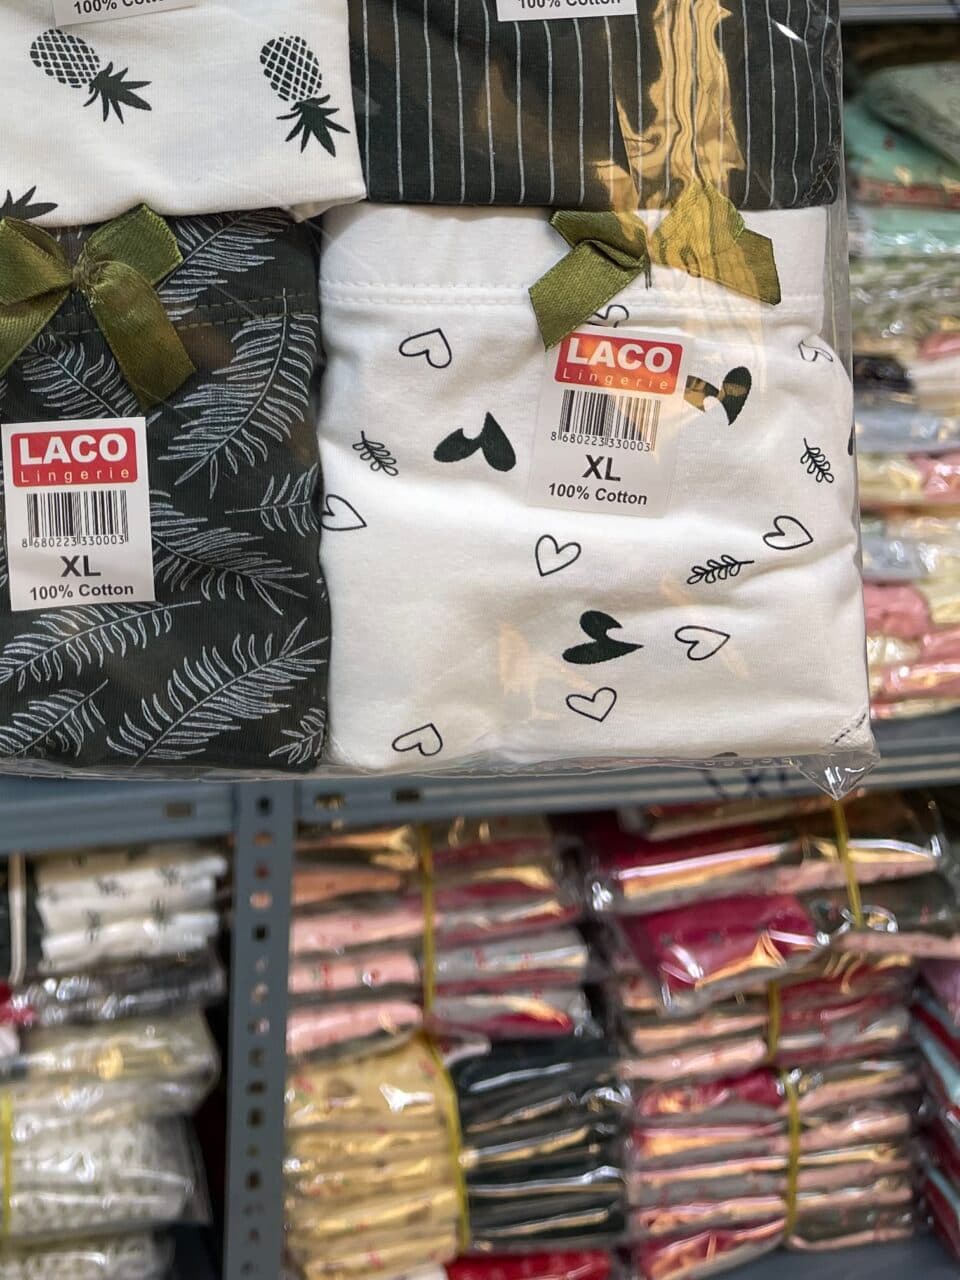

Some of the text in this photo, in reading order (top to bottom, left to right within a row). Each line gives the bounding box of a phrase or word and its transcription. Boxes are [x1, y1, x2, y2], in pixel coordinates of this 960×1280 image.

[566, 337, 673, 374] LACO
[562, 367, 669, 390] Lingerie
[19, 433, 128, 466] LACO
[20, 466, 129, 484] Lingerie
[582, 454, 621, 482] XL
[548, 482, 648, 506] 100% Cotton
[60, 555, 102, 578] XL
[30, 583, 134, 601] 100% Cotton
